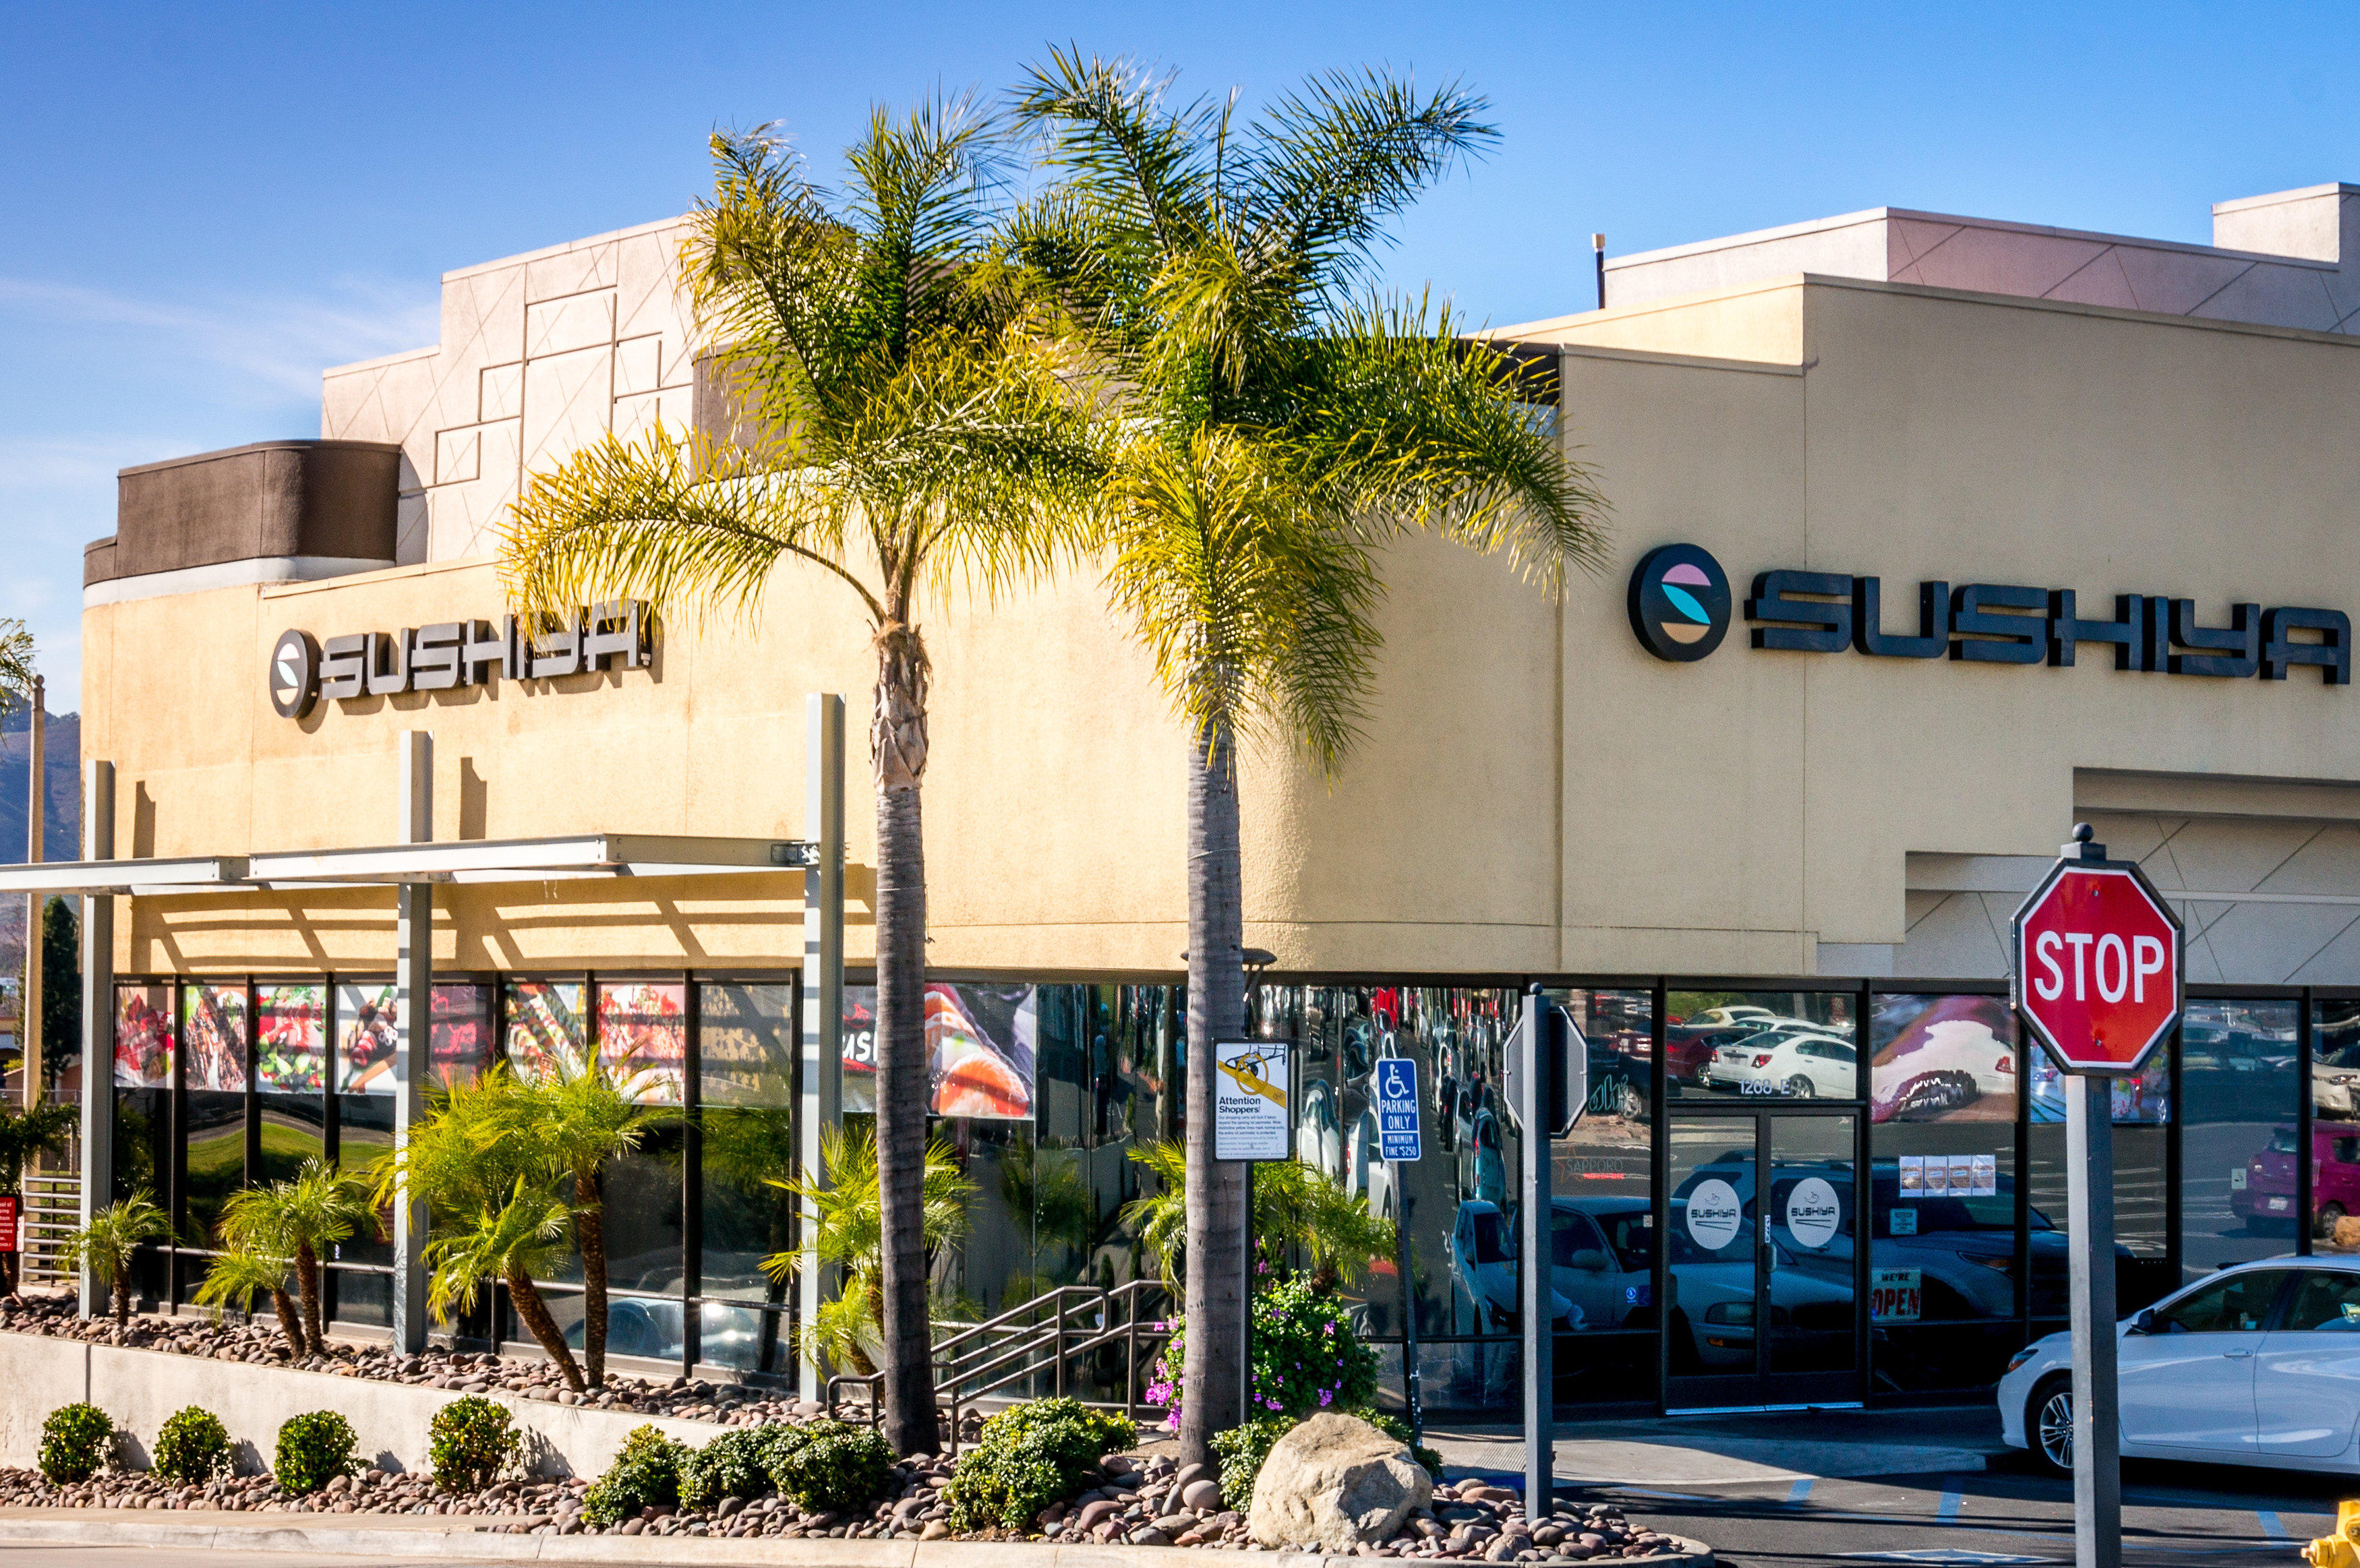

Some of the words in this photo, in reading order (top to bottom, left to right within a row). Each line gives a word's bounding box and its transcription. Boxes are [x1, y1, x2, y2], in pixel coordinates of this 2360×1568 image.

[1744, 570, 2351, 685] SUSHIYA
[320, 598, 651, 700] SUSHIYA
[2034, 930, 2164, 1003] STOP
[1219, 1096, 1261, 1105] Attention
[1382, 1099, 1416, 1114] PARKING
[1219, 1106, 1261, 1114] Shoppers!
[1388, 1116, 1411, 1130] ONLY
[1388, 1135, 1413, 1145] MINIMUM
[1386, 1146, 1398, 1156] FINE
[1399, 1147, 1417, 1157] $250
[1566, 1159, 1624, 1172] SAPPORO
[1690, 1207, 1736, 1218] SUSHIYA
[1791, 1206, 1835, 1216] SUSHIYA
[1882, 1273, 1911, 1281] WE'RE
[1872, 1288, 1920, 1315] OPEN
